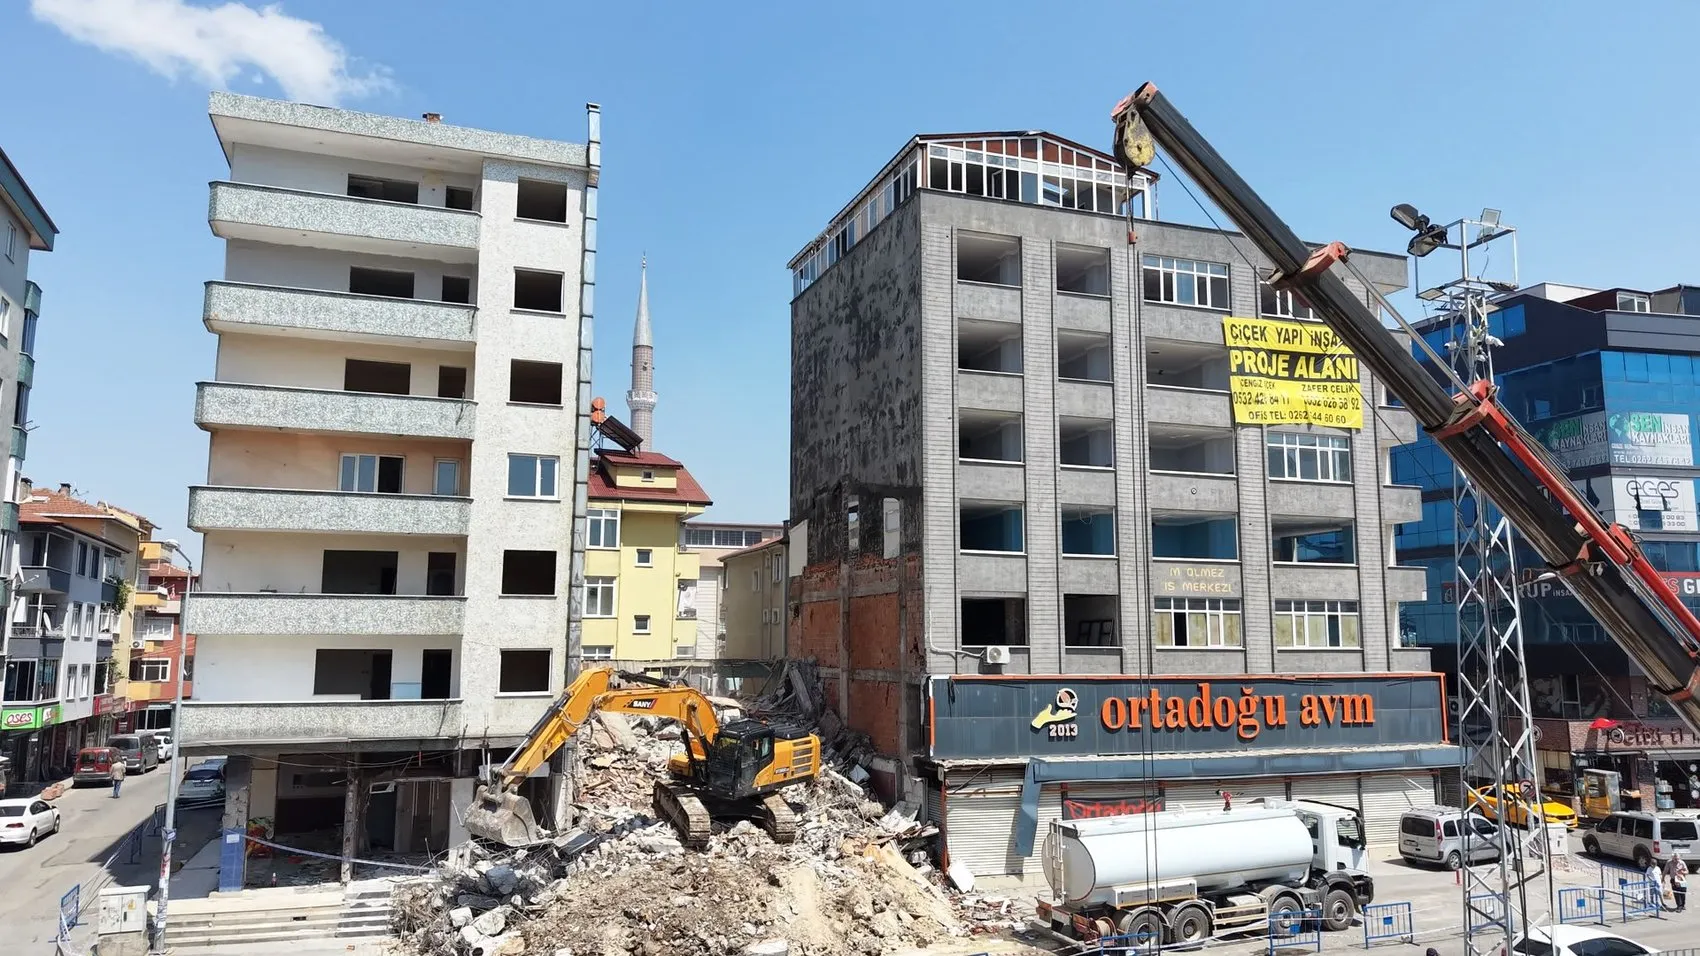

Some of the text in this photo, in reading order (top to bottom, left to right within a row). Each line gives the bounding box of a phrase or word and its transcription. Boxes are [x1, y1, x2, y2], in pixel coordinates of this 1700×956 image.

[1276, 327, 1303, 345] YAPI
[1229, 349, 1358, 379] PROJE ALANI
[632, 700, 652, 708] SANY
[1101, 682, 1376, 740] ortadoğu avm
[1049, 723, 1078, 737] 2013
